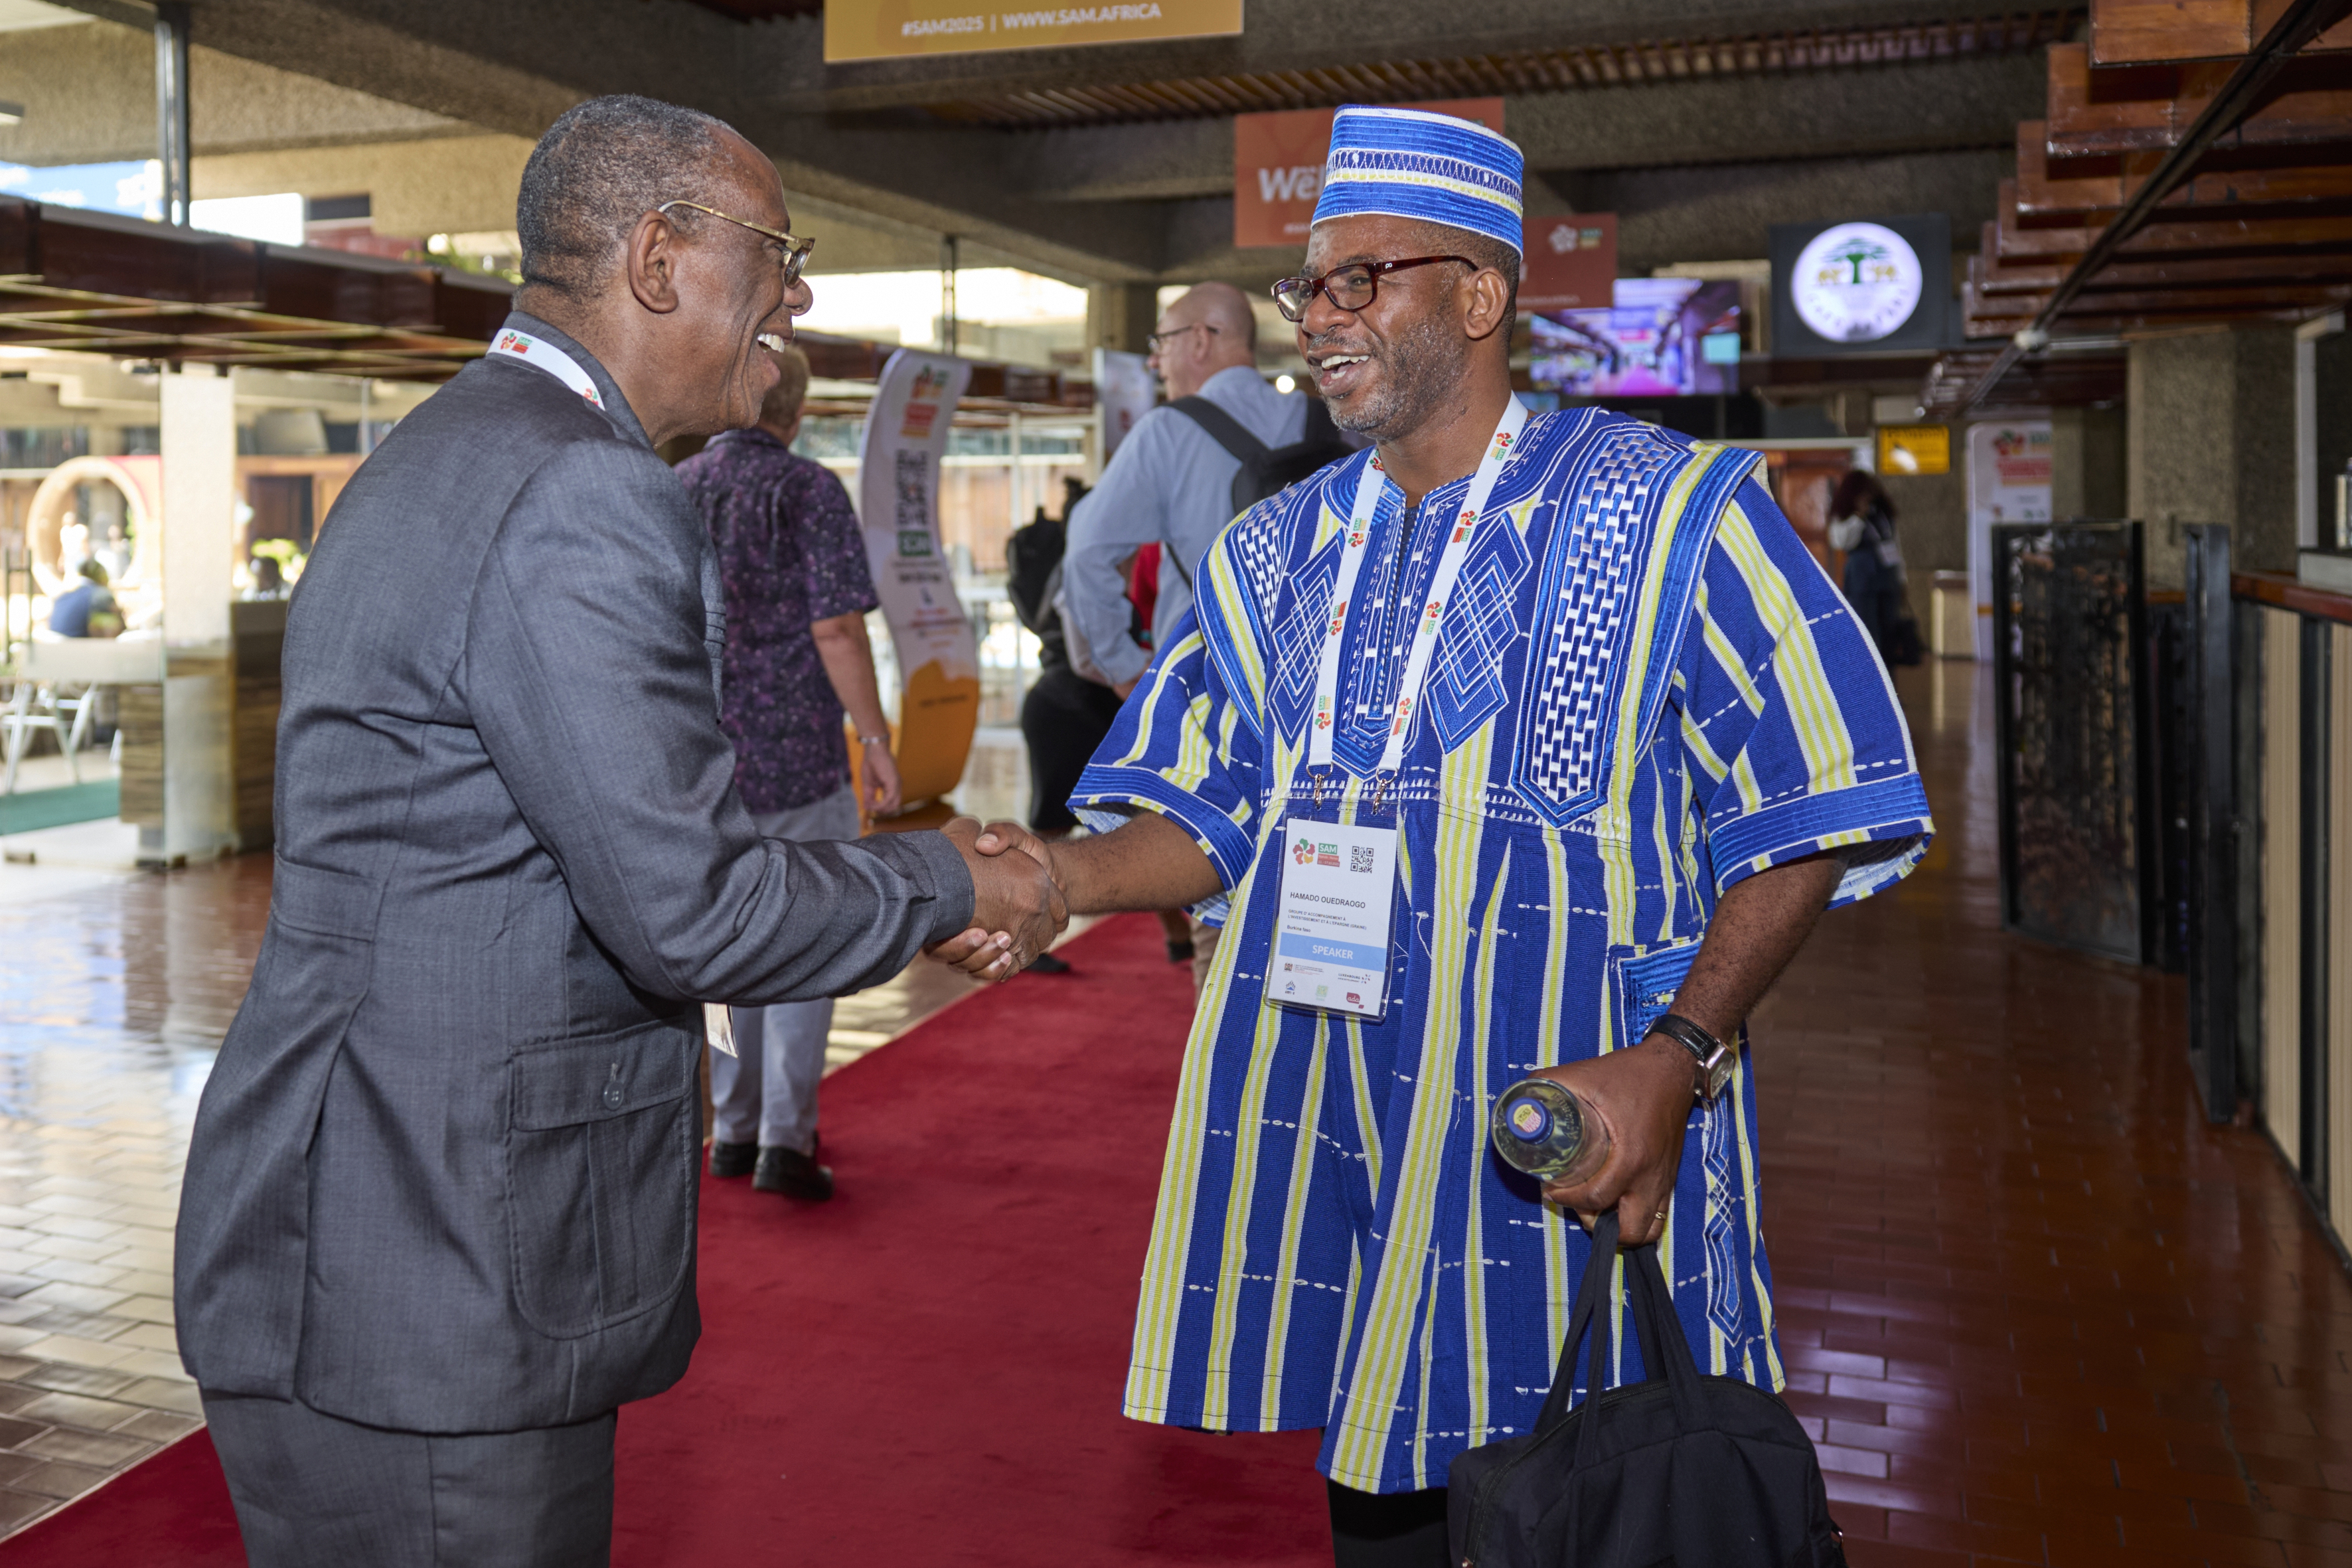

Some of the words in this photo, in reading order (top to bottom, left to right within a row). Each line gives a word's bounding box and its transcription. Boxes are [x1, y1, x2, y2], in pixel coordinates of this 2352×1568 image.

[902, 16, 984, 36] #SAM2025
[1003, 3, 1162, 29] WWW.SAM.AFRICA
[1496, 449, 1506, 460] SAM
[1461, 528, 1470, 541] SAM
[1427, 621, 1435, 634] SAM
[1320, 844, 1336, 853] SAM
[1291, 892, 1319, 902] HAMADO
[1321, 896, 1366, 909] OUEDRAOGO
[1312, 945, 1353, 960] SPEAKER
